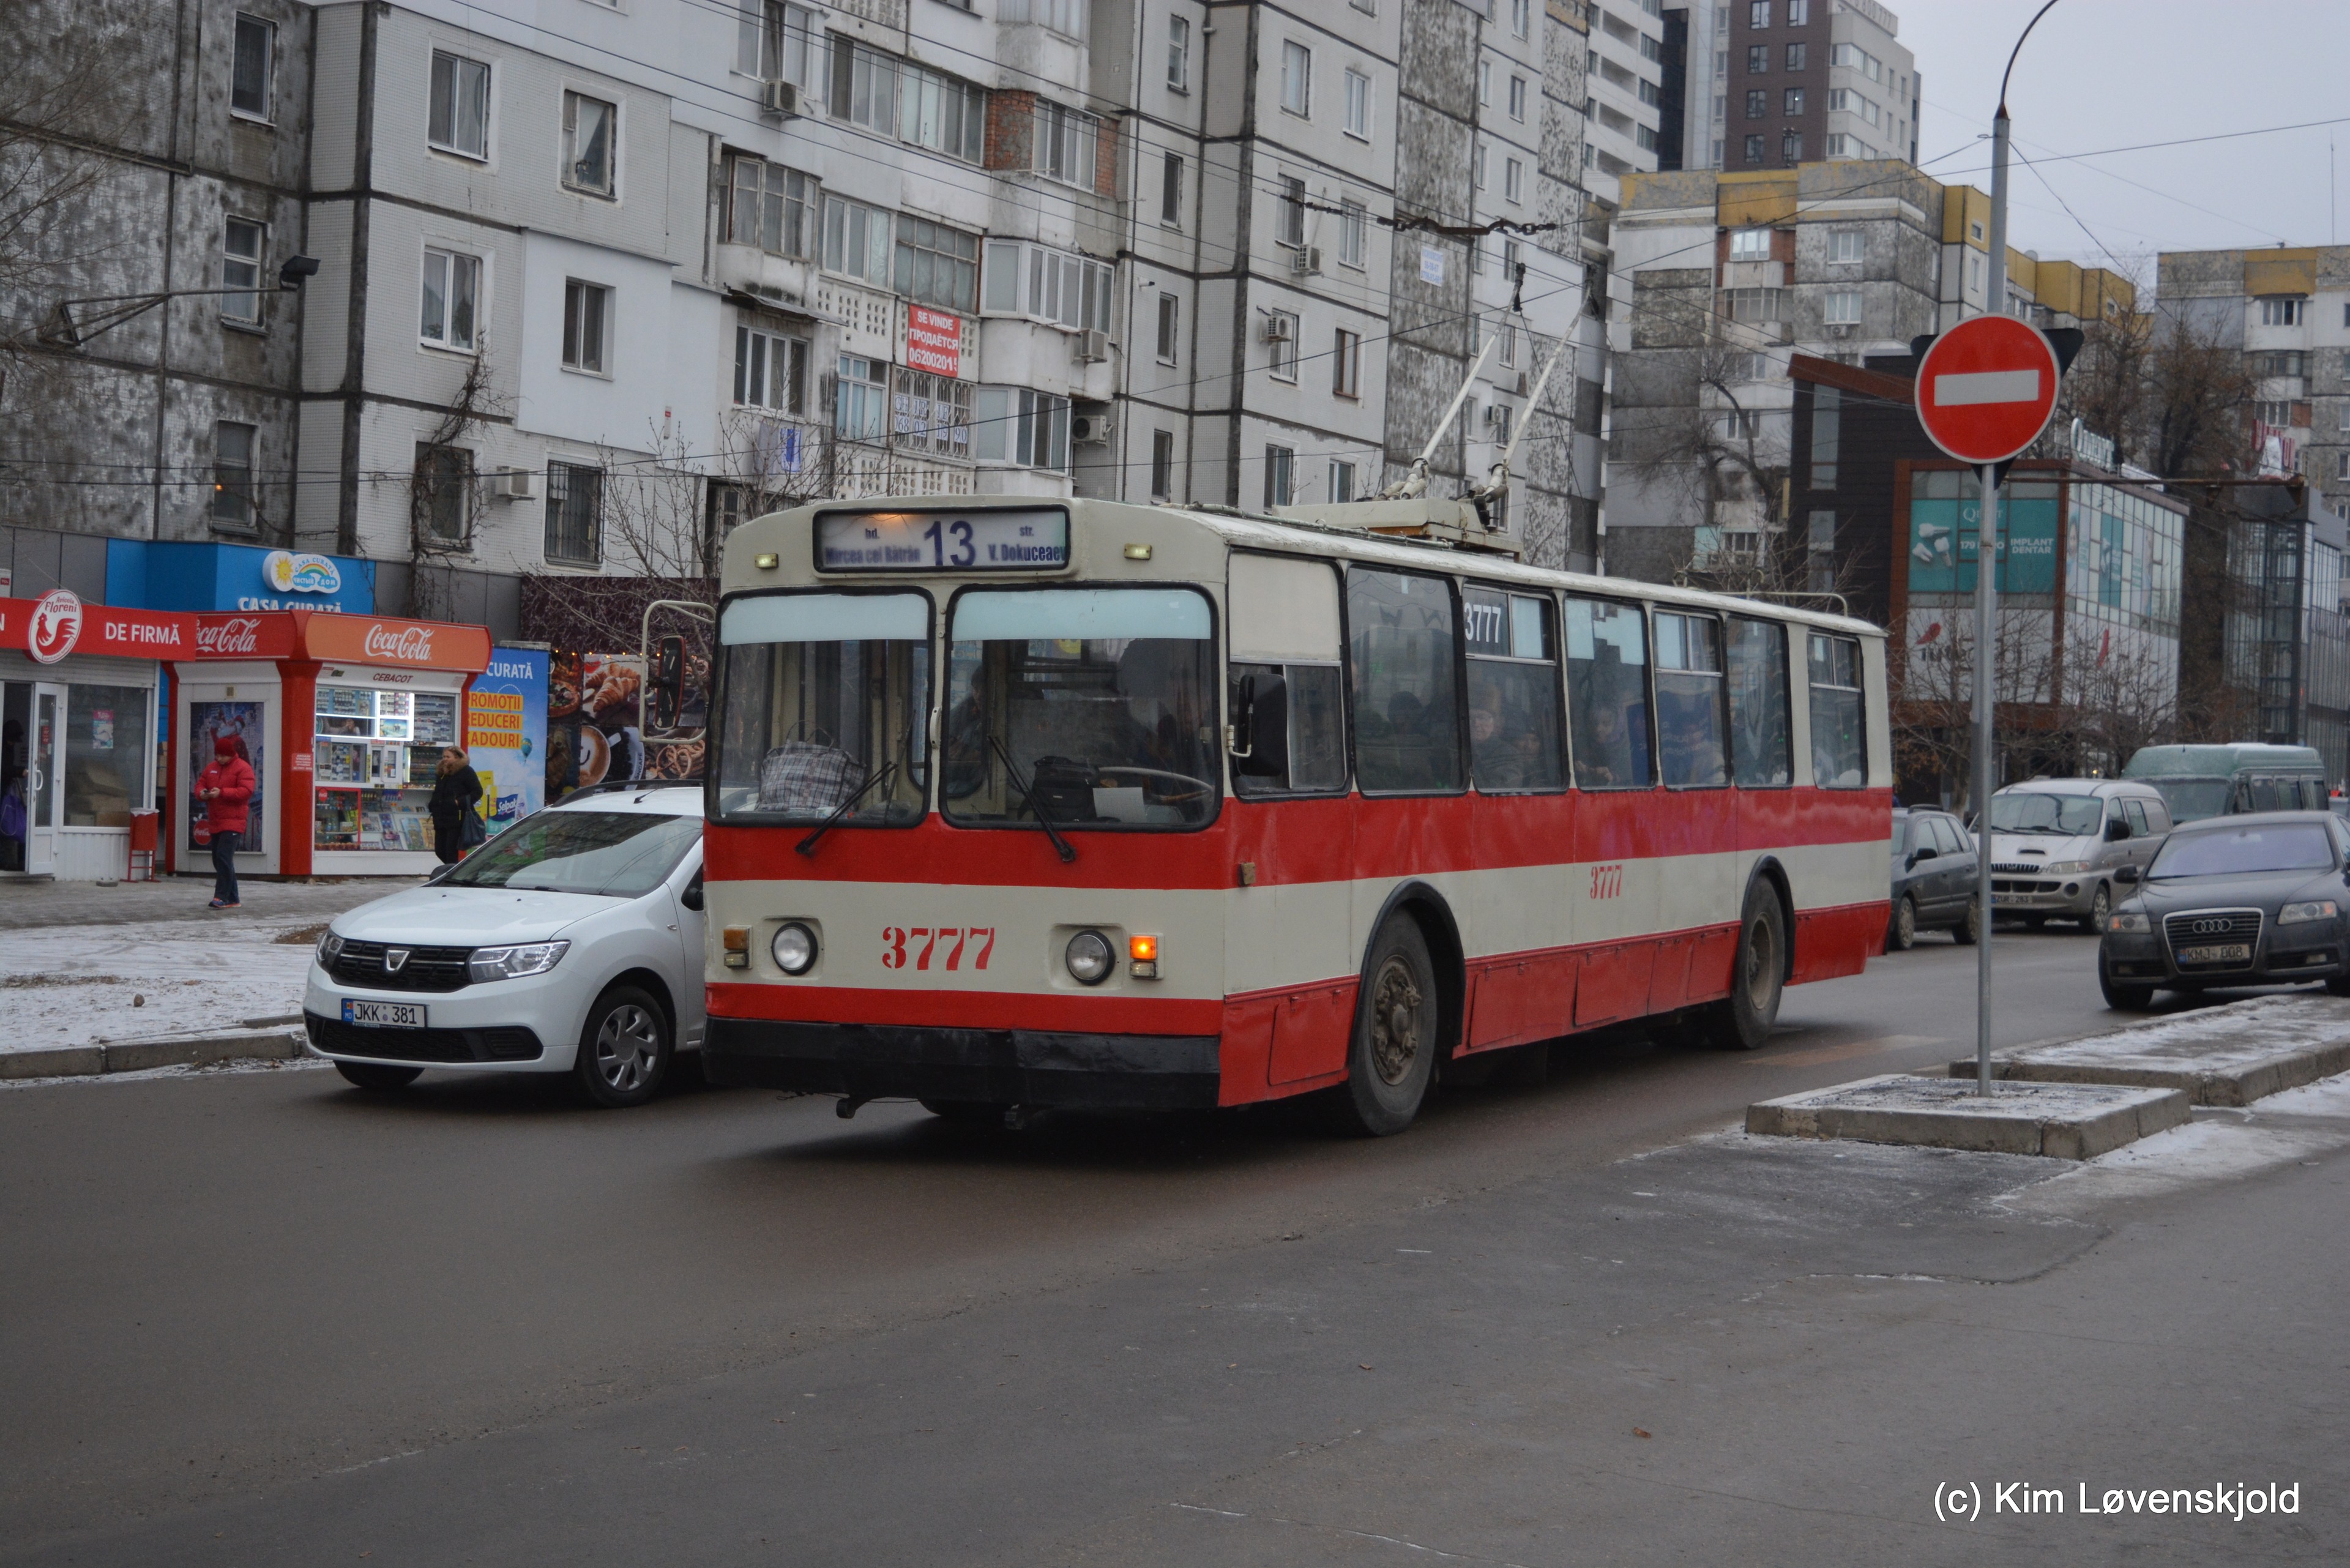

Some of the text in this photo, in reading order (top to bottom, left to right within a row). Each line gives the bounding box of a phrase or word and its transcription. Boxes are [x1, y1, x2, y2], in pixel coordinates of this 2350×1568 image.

[917, 311, 953, 330] SE VINDE
[909, 328, 958, 351] ПРОДАЁТСЯ
[1019, 525, 1035, 537] str.
[924, 520, 977, 567] 13
[2010, 538, 2054, 547] IMPLANT
[2012, 546, 2051, 554] DENTAR
[988, 543, 998, 562] V.
[45, 602, 78, 613] Floreni
[1464, 602, 1501, 643] 3777
[105, 622, 181, 645] DE FIRMĂ
[196, 618, 262, 653] oca-Cola
[365, 624, 435, 661] Coca-Cola
[372, 673, 414, 684] CEBACOT
[486, 661, 534, 680] CURATĂ
[469, 693, 521, 713] ROMOȚII
[469, 712, 520, 729] EDUCERI
[469, 731, 520, 748] ADOURI
[1590, 864, 1622, 900] 3777
[882, 926, 996, 971] 3777
[2220, 946, 2243, 958] 008
[355, 1003, 417, 1025] JKK 381
